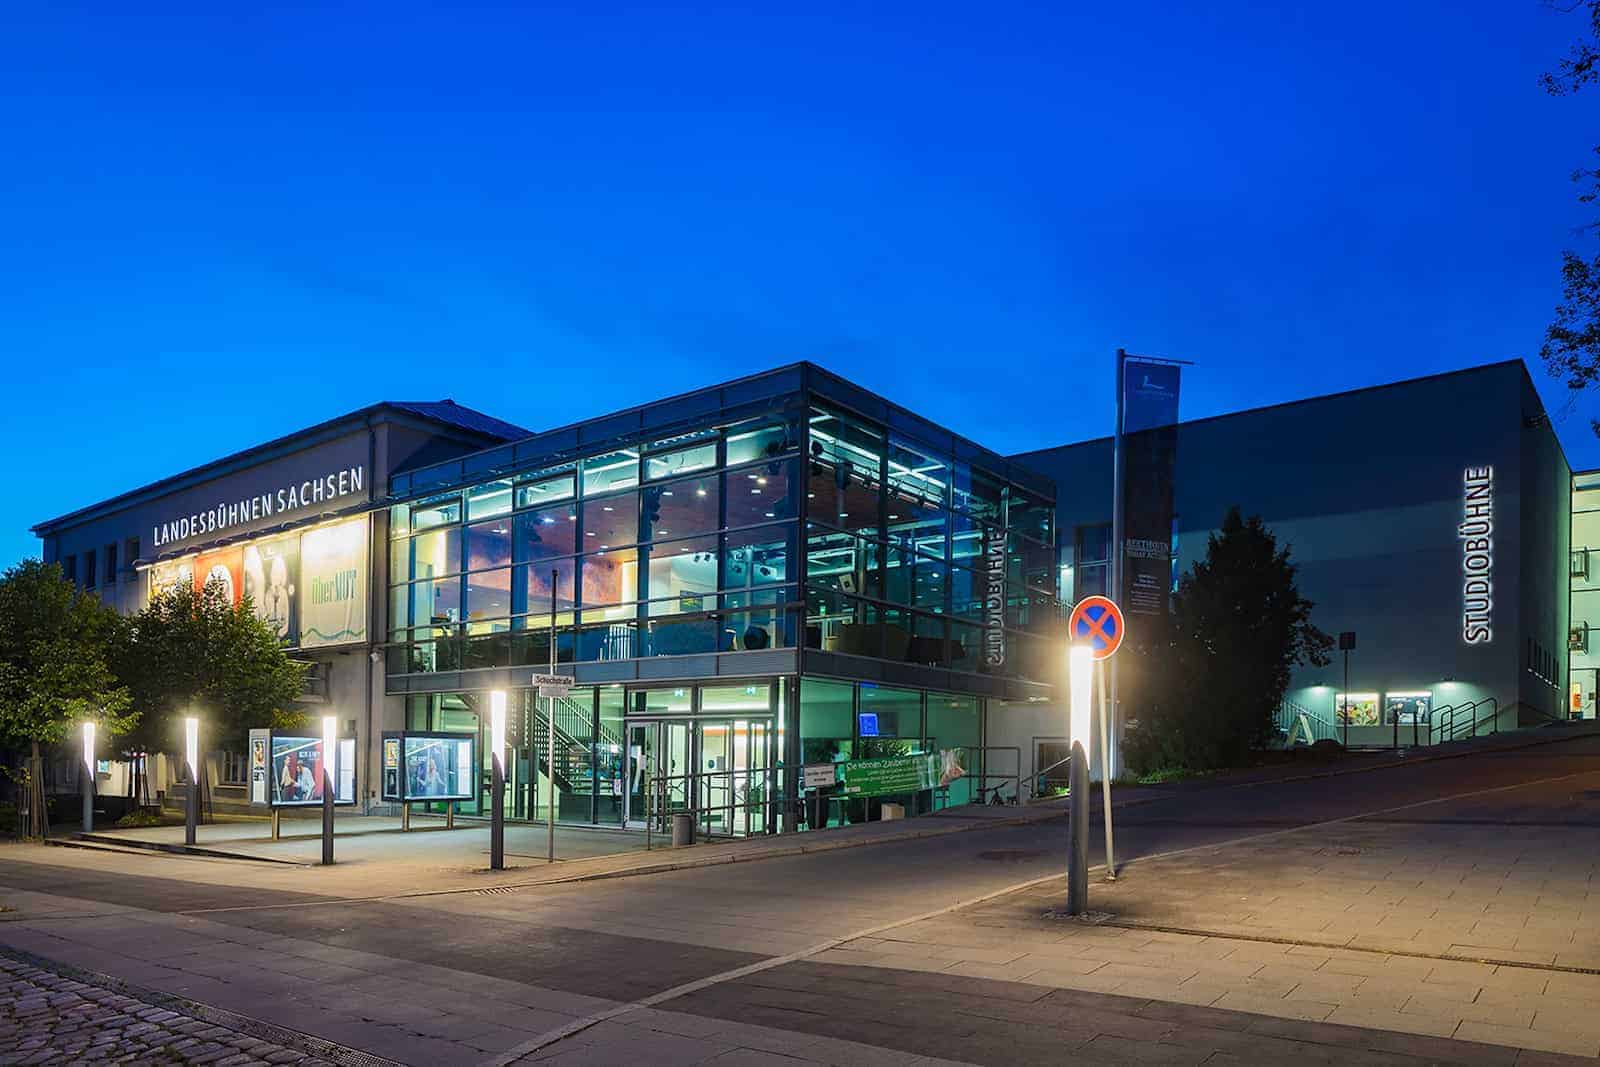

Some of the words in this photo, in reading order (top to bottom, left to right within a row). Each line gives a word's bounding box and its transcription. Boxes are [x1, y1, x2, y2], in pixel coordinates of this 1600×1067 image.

[154, 493, 272, 546] LANDESBÜHNEN
[277, 466, 363, 513] SACHSEN
[1459, 466, 1492, 643] STUDIOBÜHNE
